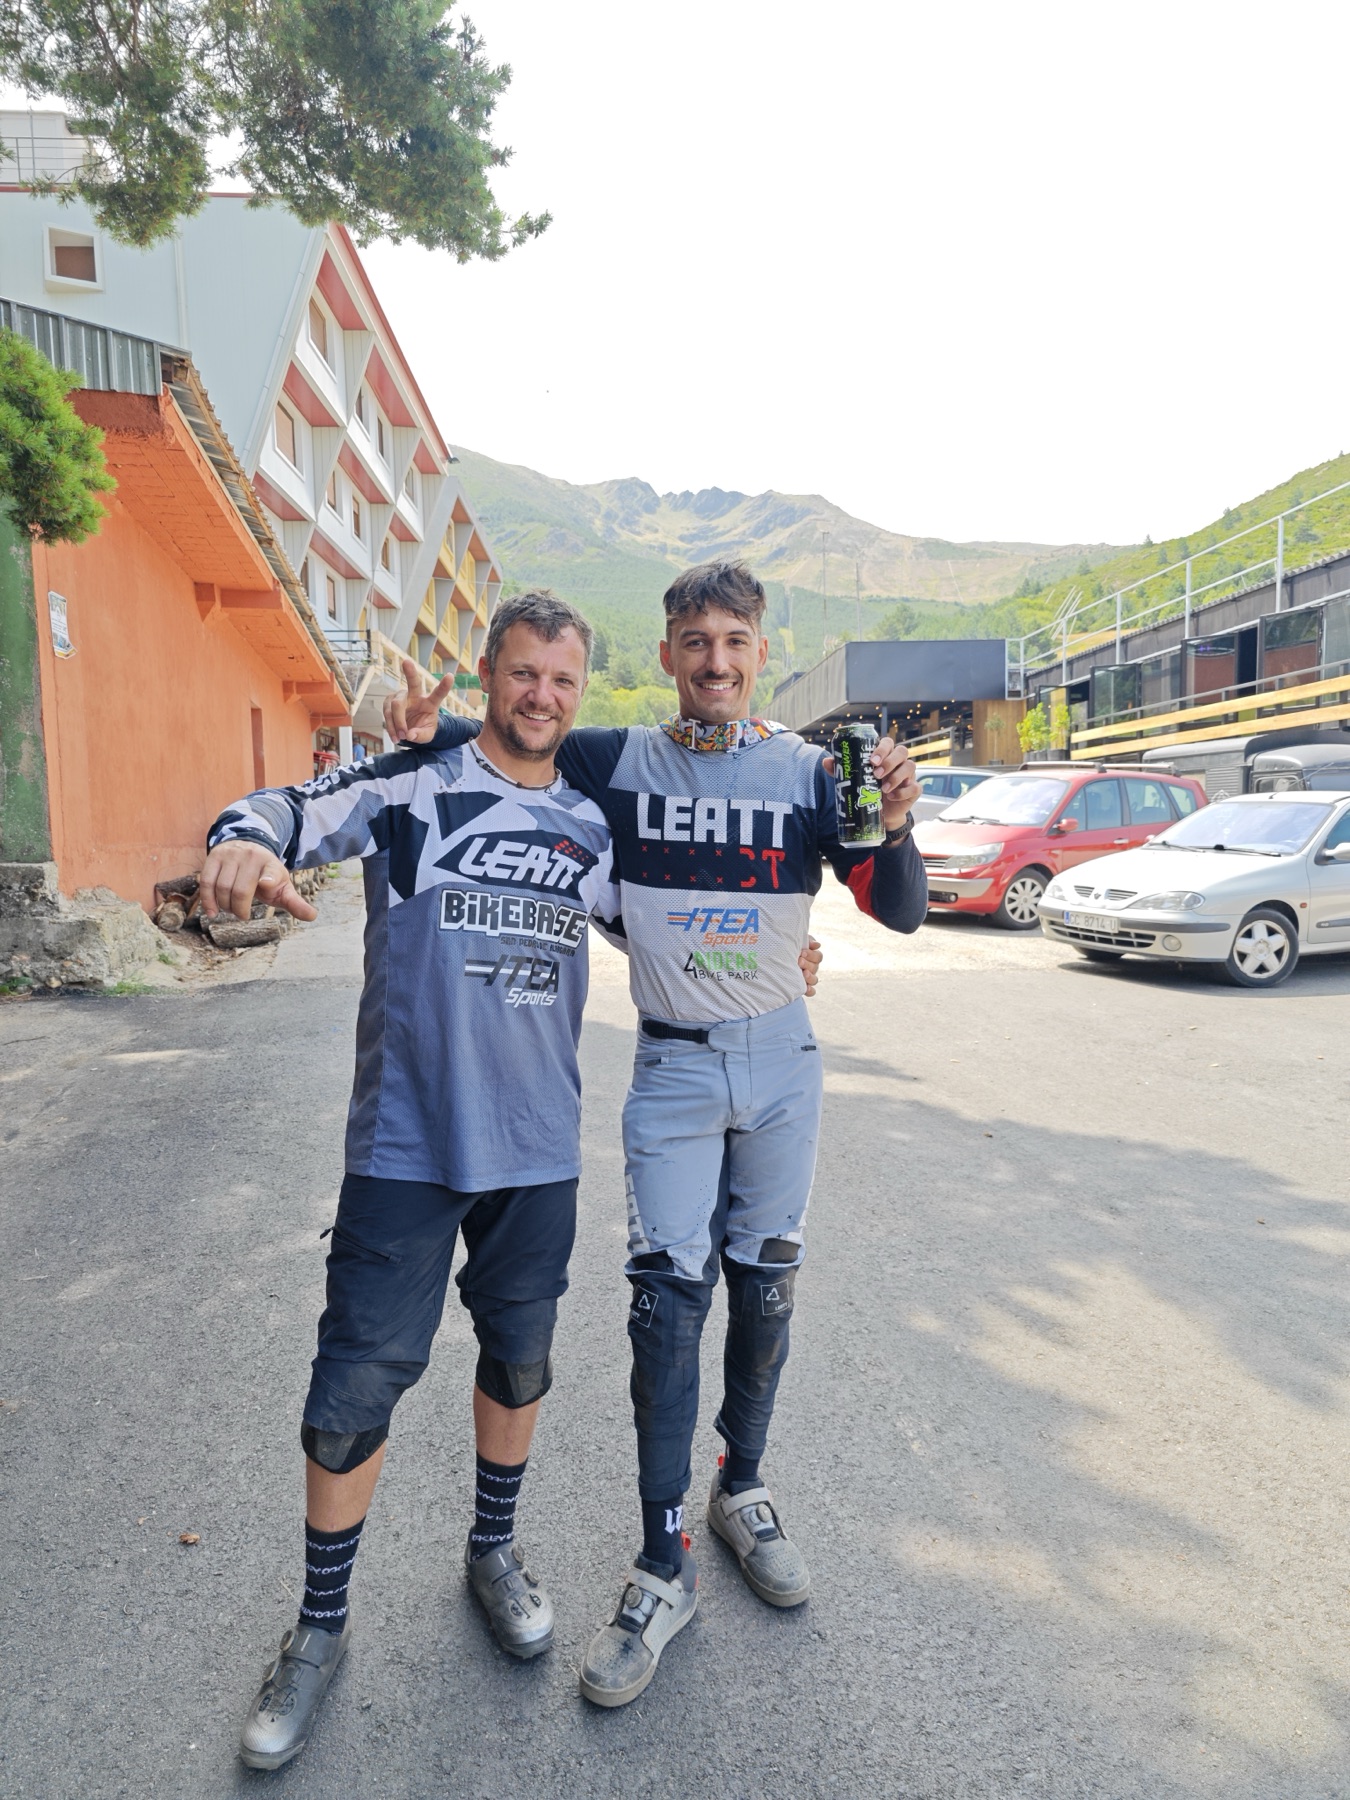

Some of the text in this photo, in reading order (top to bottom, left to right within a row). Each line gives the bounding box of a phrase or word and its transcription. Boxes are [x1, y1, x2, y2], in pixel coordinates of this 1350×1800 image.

[841, 740, 851, 779] POWER
[637, 792, 793, 848] LEATT
[458, 837, 584, 889] LEATT
[702, 932, 759, 947] Sports
[727, 970, 758, 980] PARK
[505, 987, 557, 1008] Sports
